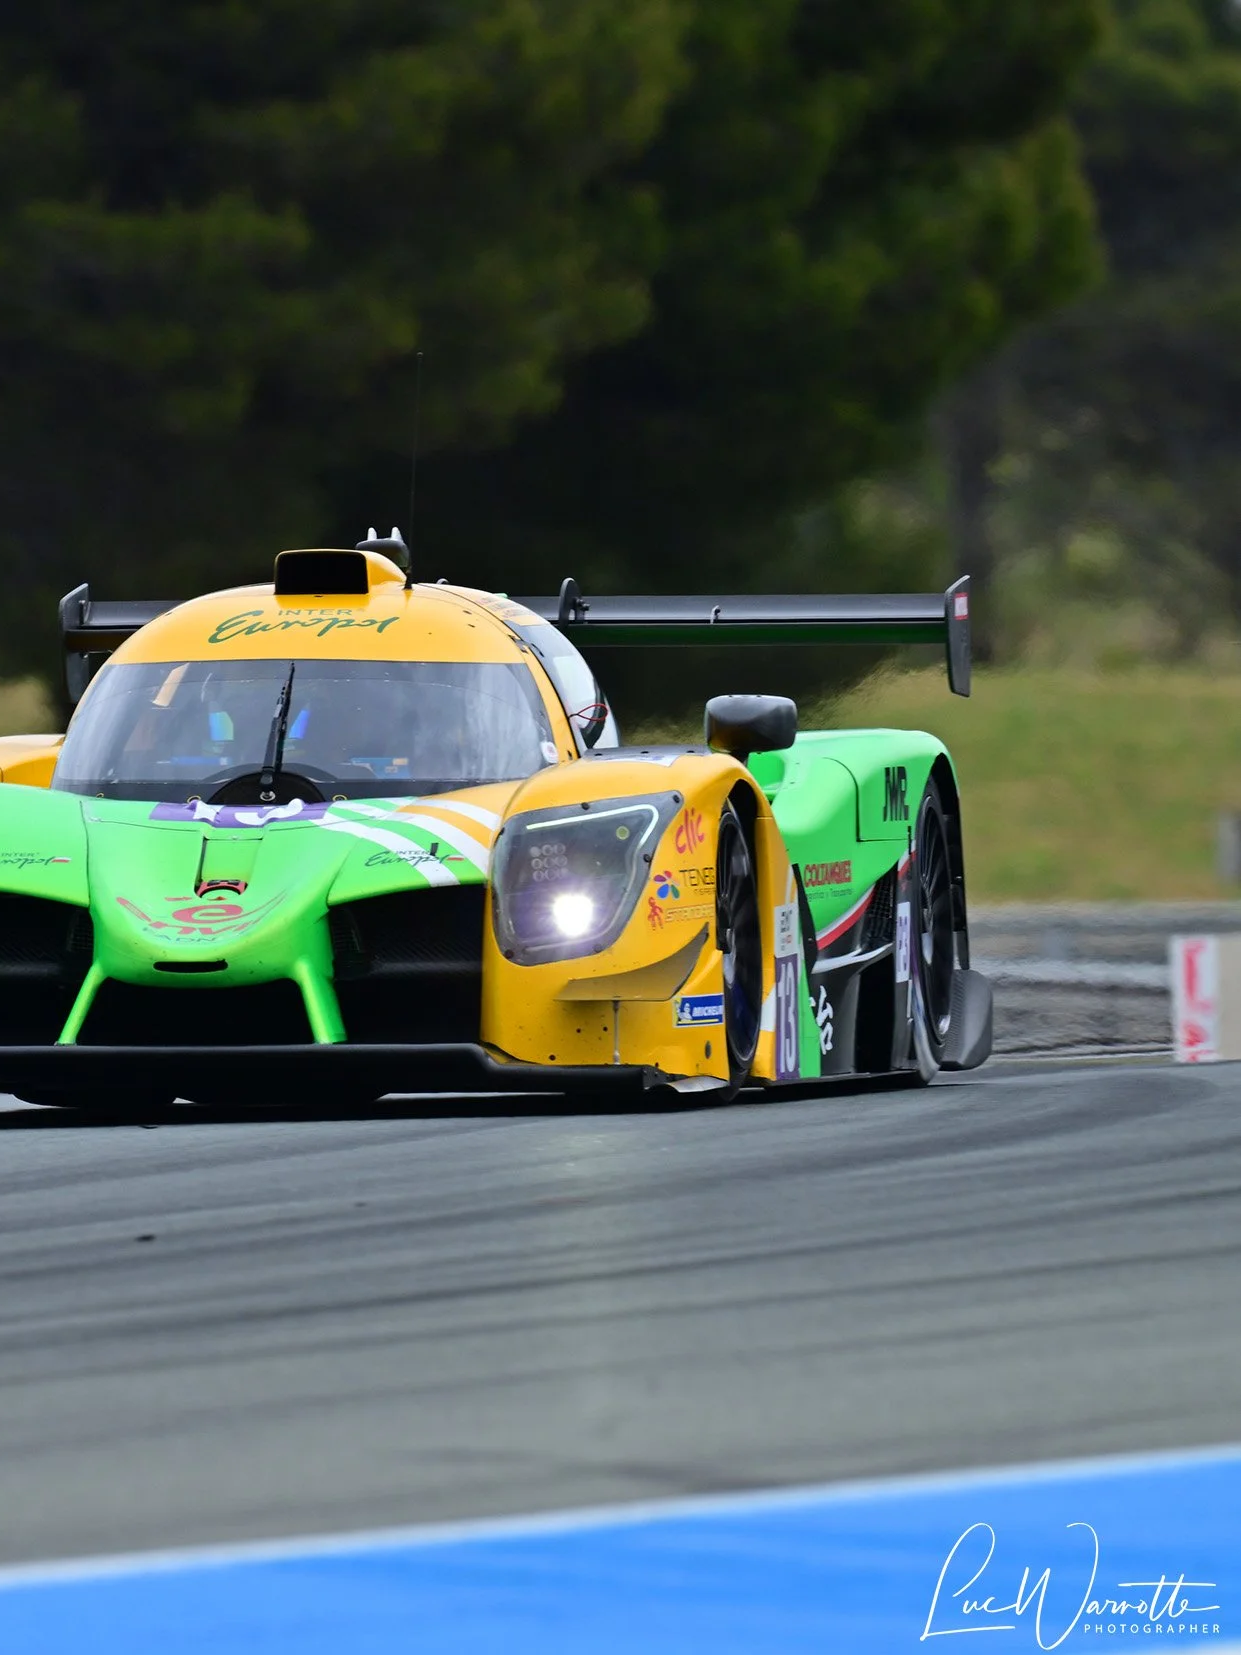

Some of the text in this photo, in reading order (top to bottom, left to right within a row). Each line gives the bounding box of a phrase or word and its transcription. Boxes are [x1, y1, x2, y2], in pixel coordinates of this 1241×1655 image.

[207, 609, 400, 644] Europol
[277, 608, 353, 616] INTER
[777, 961, 797, 1073] 13
